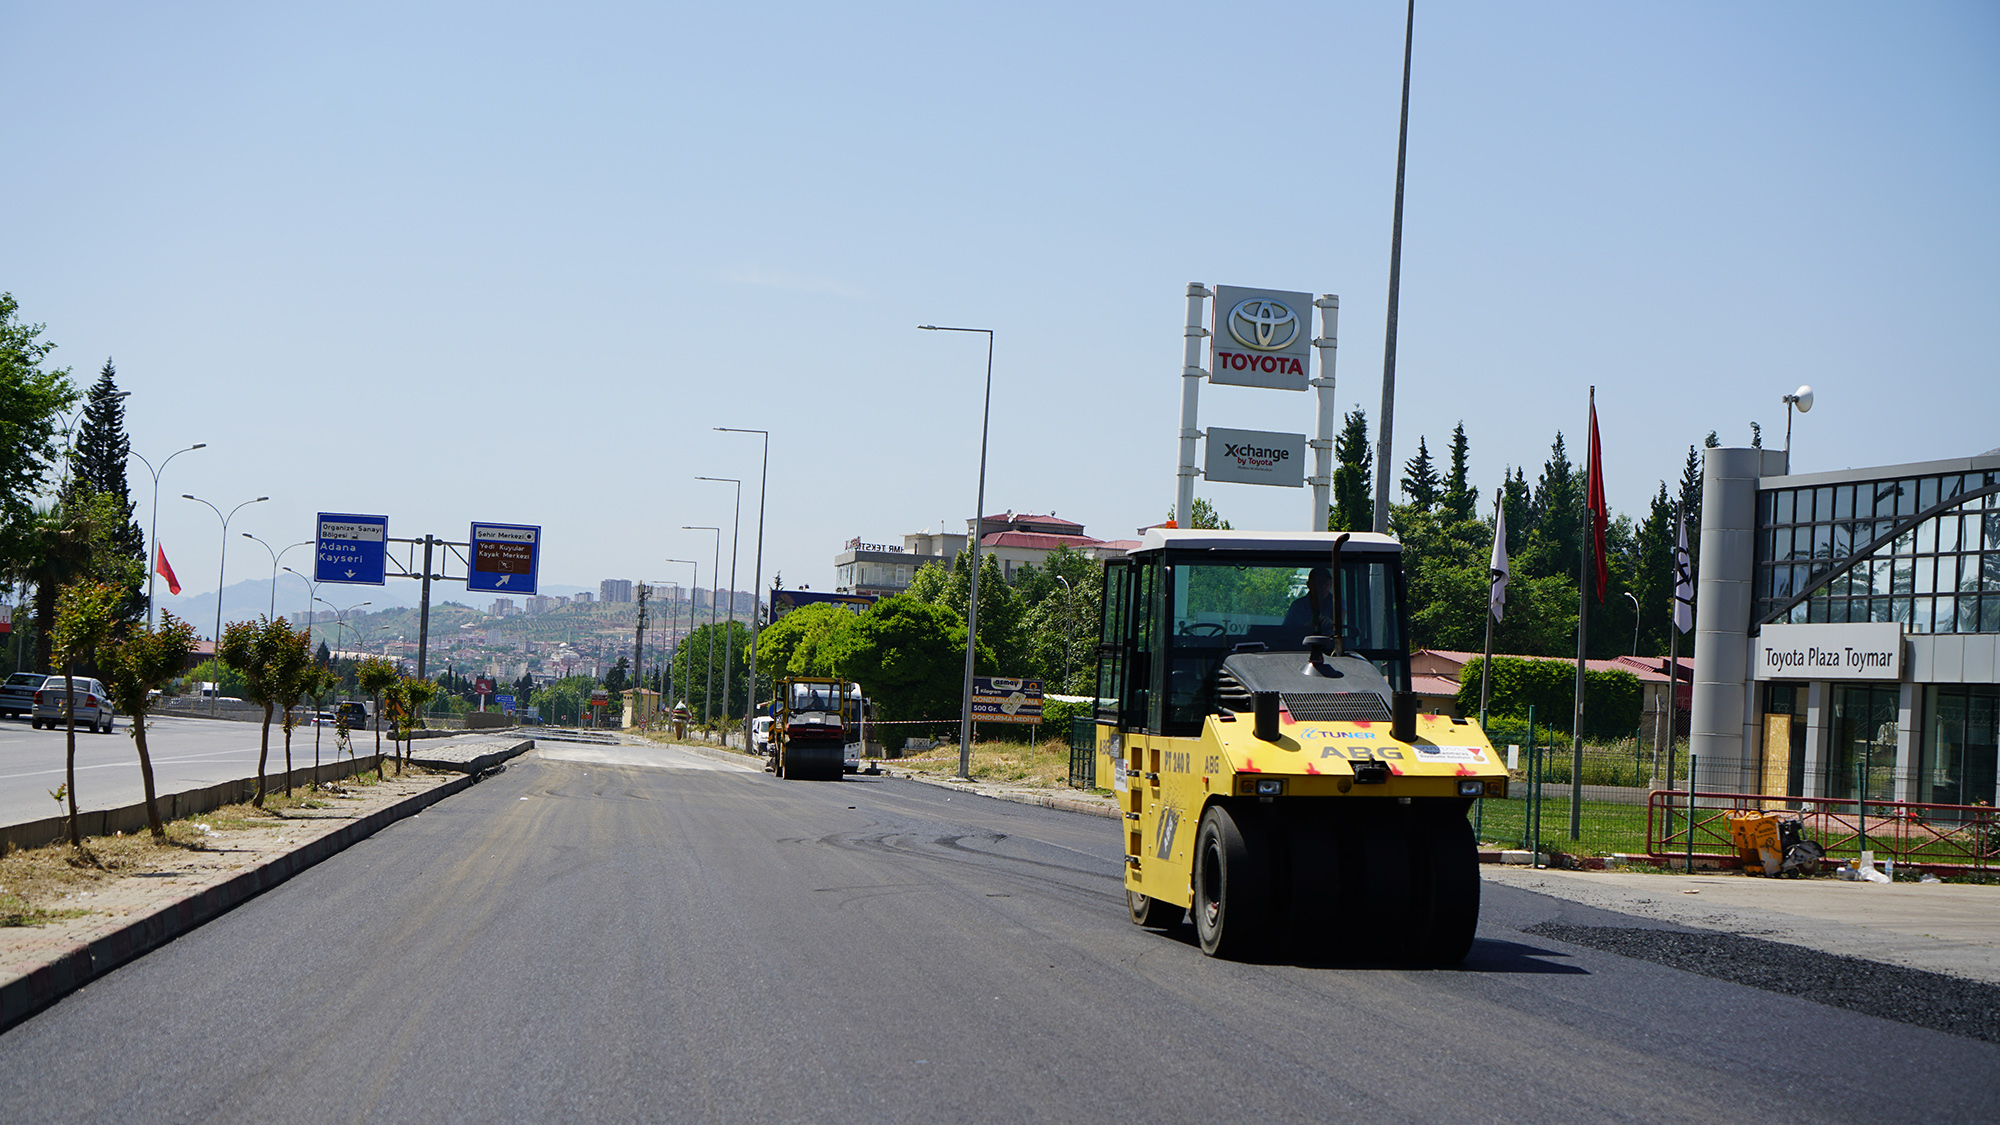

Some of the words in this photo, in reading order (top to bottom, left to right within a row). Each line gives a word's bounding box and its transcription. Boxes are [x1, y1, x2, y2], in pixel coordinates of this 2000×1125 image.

[1218, 352, 1304, 376] TOYOTA
[1224, 443, 1290, 462] Xchange
[1237, 456, 1247, 466] by
[1248, 457, 1273, 467] Toyota
[322, 524, 354, 532] Organize
[357, 526, 382, 534] Sanayi
[322, 531, 347, 539] Bölgesi
[497, 532, 524, 540] Merkezi
[320, 542, 356, 552] Adana
[499, 544, 525, 552] Kuyular
[319, 552, 363, 564] Kayseri
[478, 550, 499, 559] Kayak
[502, 552, 530, 560] Merkezi
[1765, 648, 1804, 672] Toyota
[1808, 647, 1840, 667] Plaza
[1844, 647, 1893, 672] Toymar
[974, 685, 980, 695] 1
[972, 714, 1013, 722] DONDURMA
[1318, 731, 1376, 740] TUNER
[1320, 746, 1404, 760] ABG
[1173, 751, 1184, 774] 240
[1185, 752, 1191, 774] R
[1204, 755, 1219, 774] ABG
